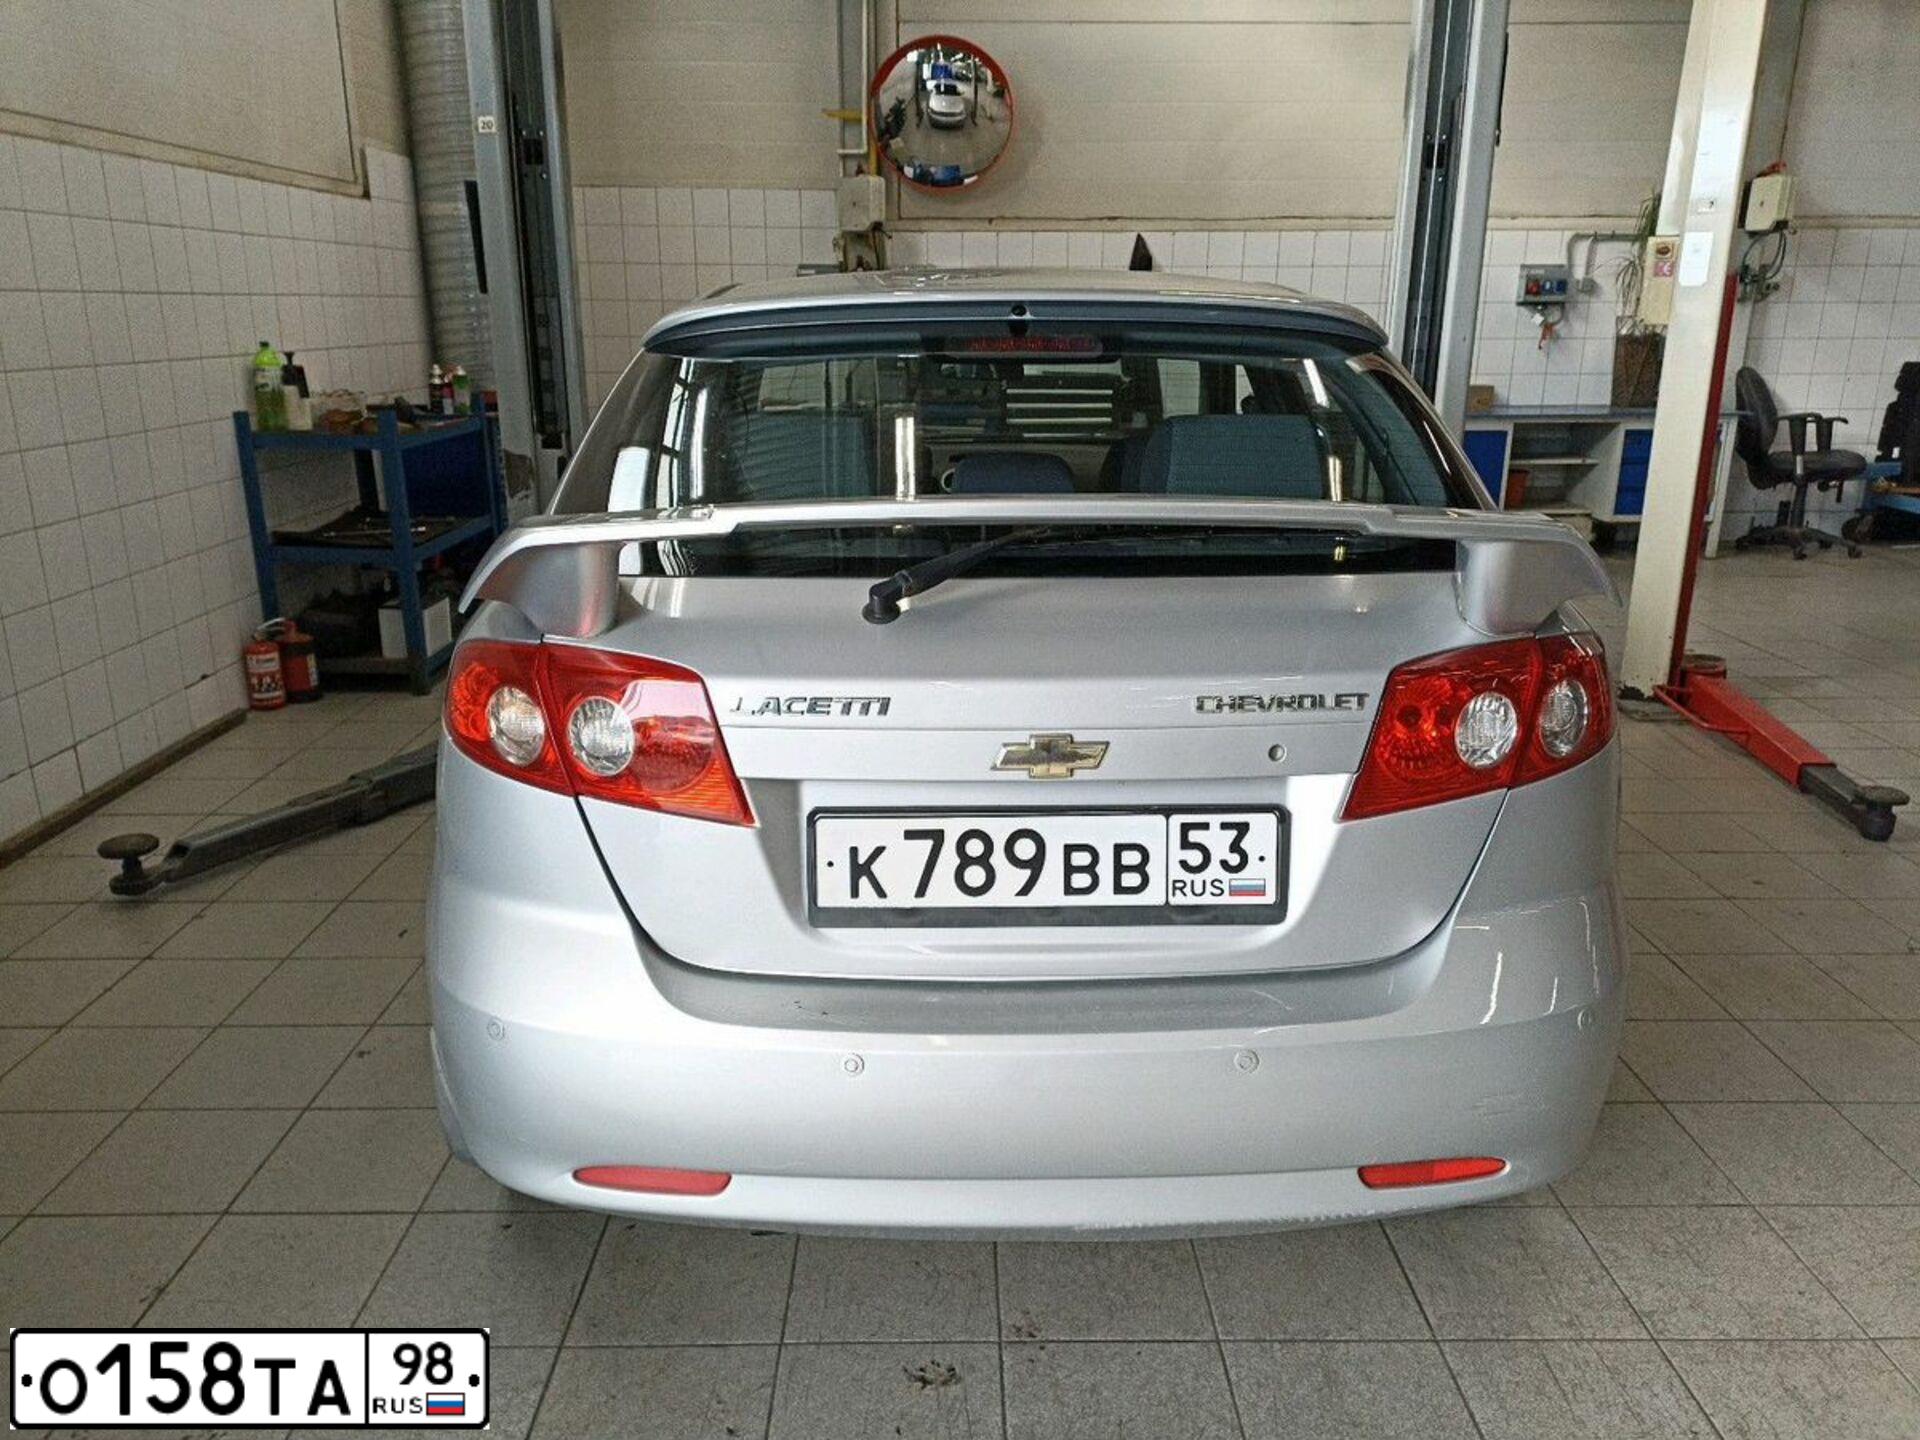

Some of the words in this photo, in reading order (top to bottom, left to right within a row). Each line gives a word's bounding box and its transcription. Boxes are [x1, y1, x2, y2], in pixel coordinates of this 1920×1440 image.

[730, 697, 891, 716] LACETTI
[1196, 693, 1370, 714] CHEVROLET
[1178, 821, 1250, 875] 53
[1172, 878, 1225, 897] RUS
